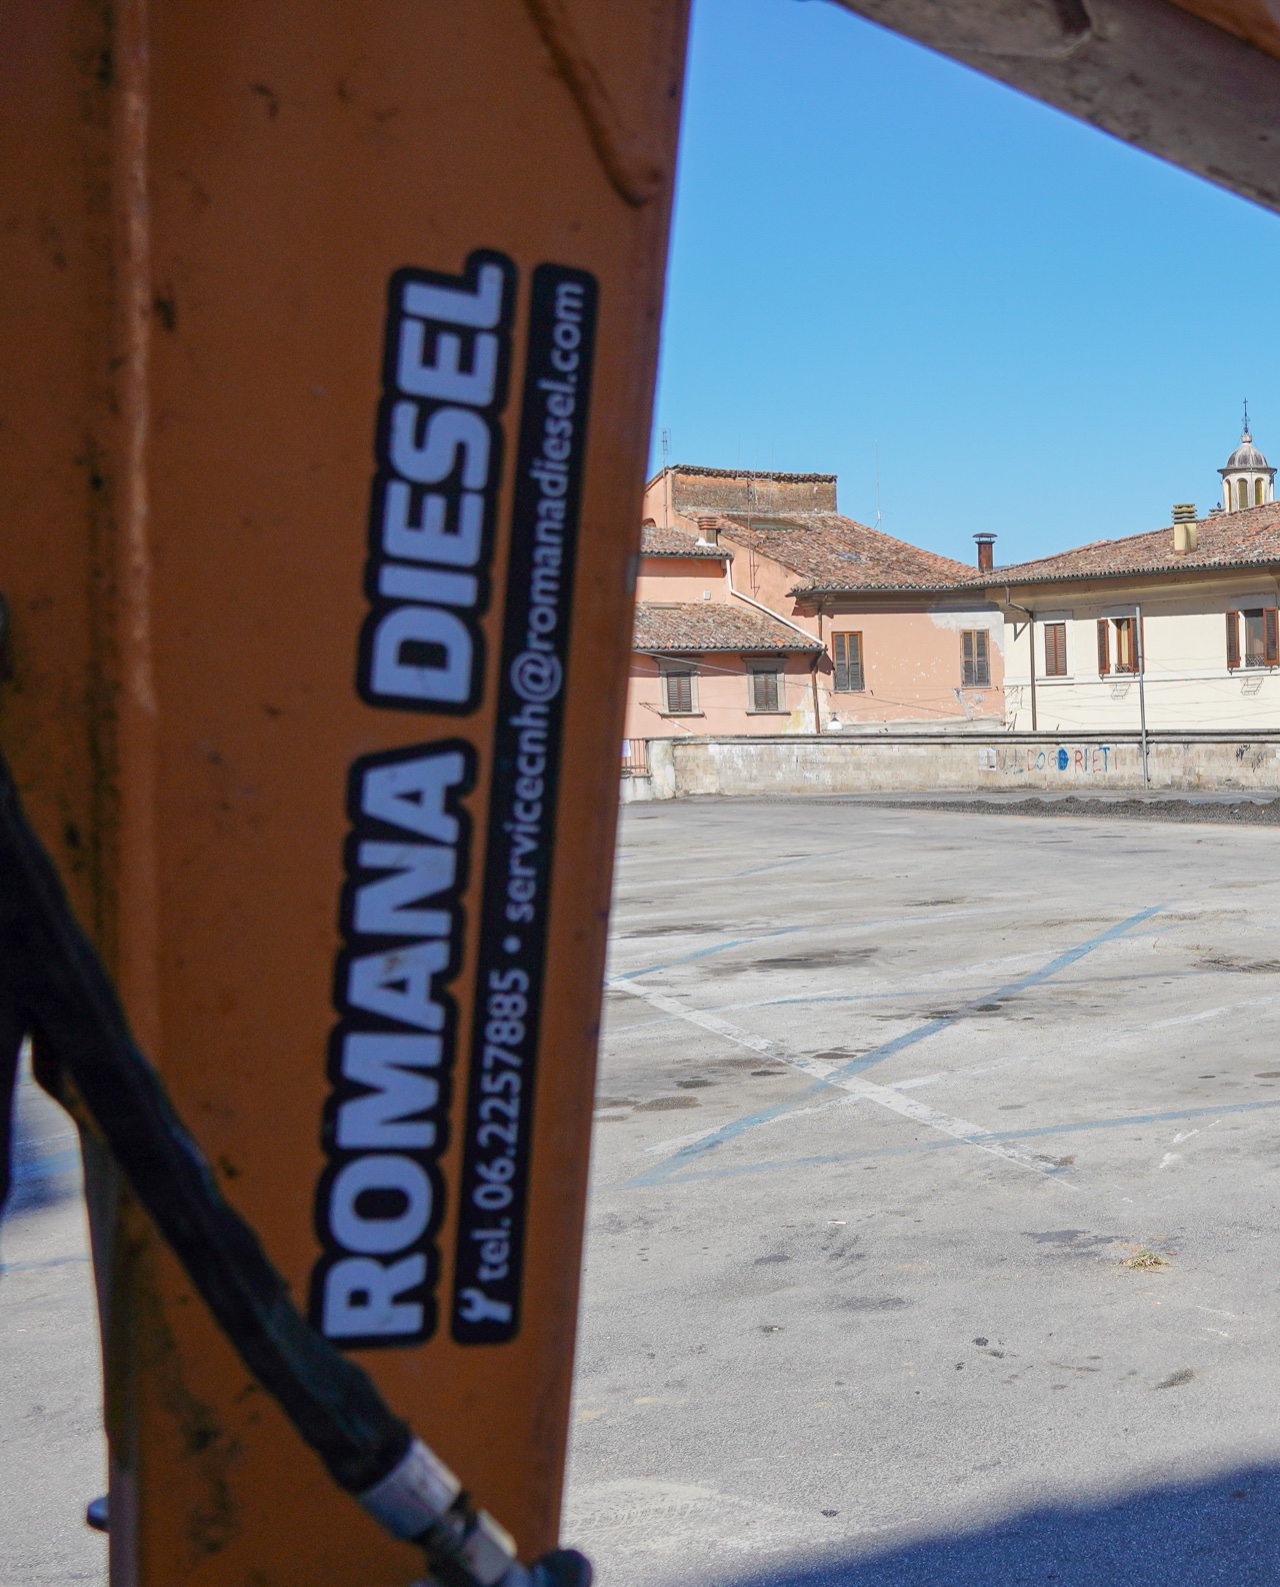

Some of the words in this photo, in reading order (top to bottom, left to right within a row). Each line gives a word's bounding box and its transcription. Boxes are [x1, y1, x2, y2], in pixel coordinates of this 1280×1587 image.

[369, 263, 504, 704] DIESEL
[503, 281, 584, 923] servicecnh@romanadiesel.com
[322, 752, 465, 1339] ROMANA
[472, 968, 529, 1211] 06.2257885
[472, 1218, 512, 1282] tel.
